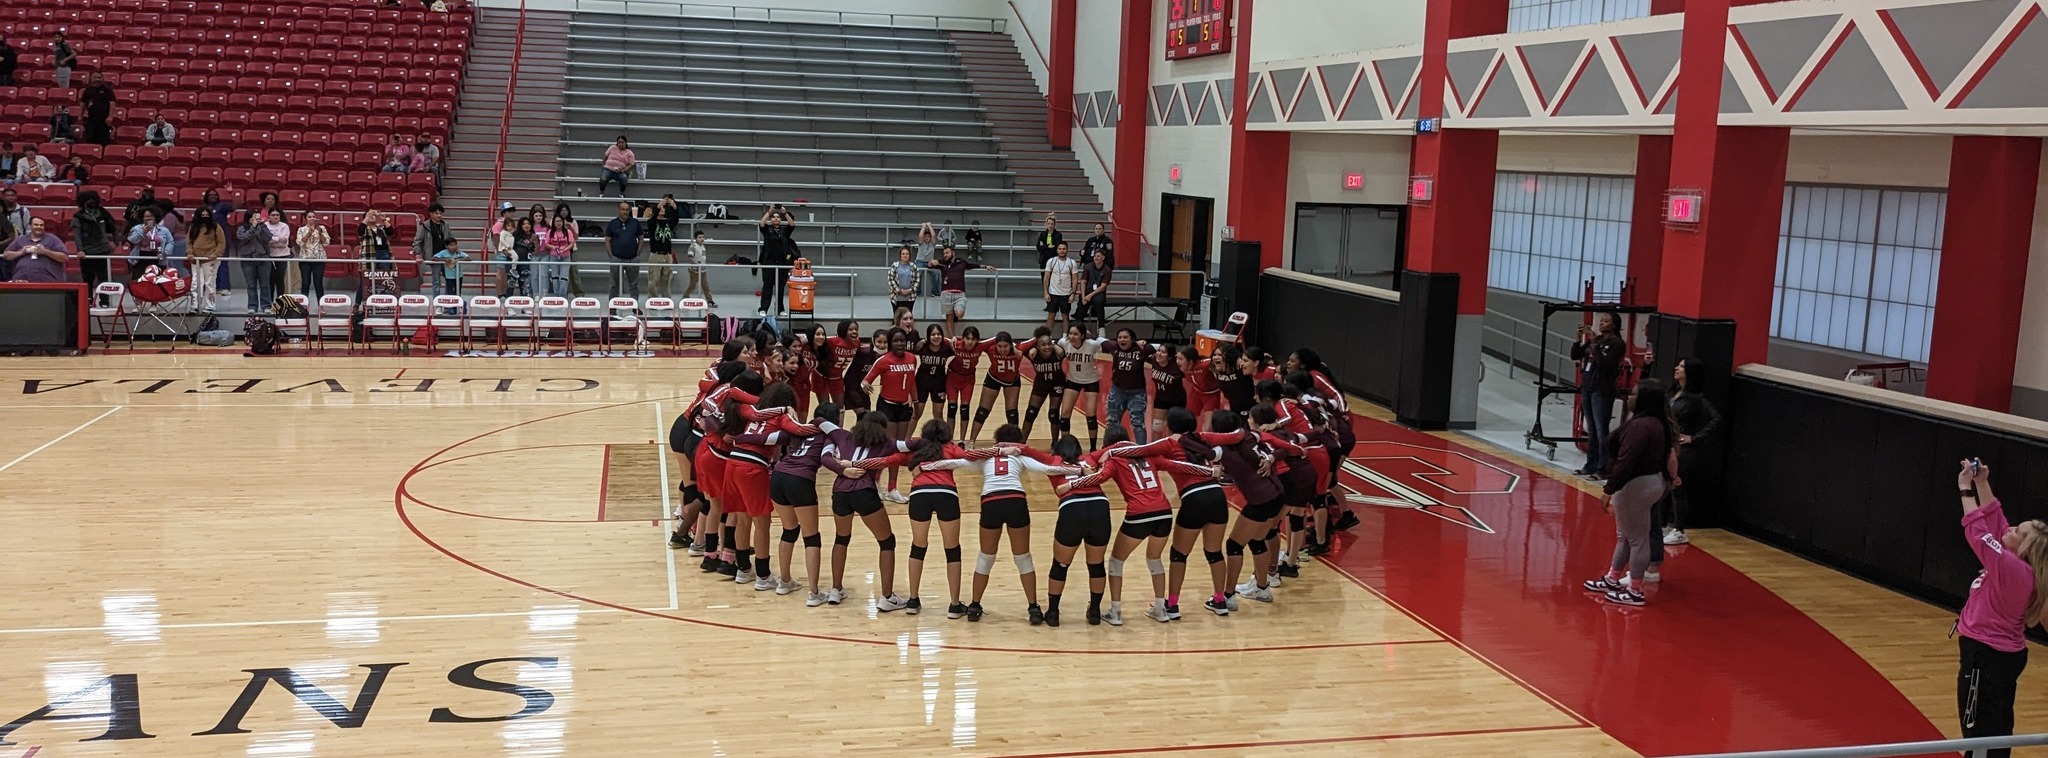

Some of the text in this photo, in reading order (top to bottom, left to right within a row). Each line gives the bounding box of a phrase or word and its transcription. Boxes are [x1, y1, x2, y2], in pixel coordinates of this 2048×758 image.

[1347, 175, 1362, 187] EXIT
[1673, 200, 1691, 217] EXIT
[962, 358, 971, 369] 5
[997, 359, 1016, 373] 24
[1119, 360, 1133, 371] 25
[903, 373, 908, 390] 1
[1044, 372, 1053, 381] 14
[0, 378, 600, 395] CLEVELA
[1128, 461, 1159, 490] 15
[0, 656, 559, 746] ANS
